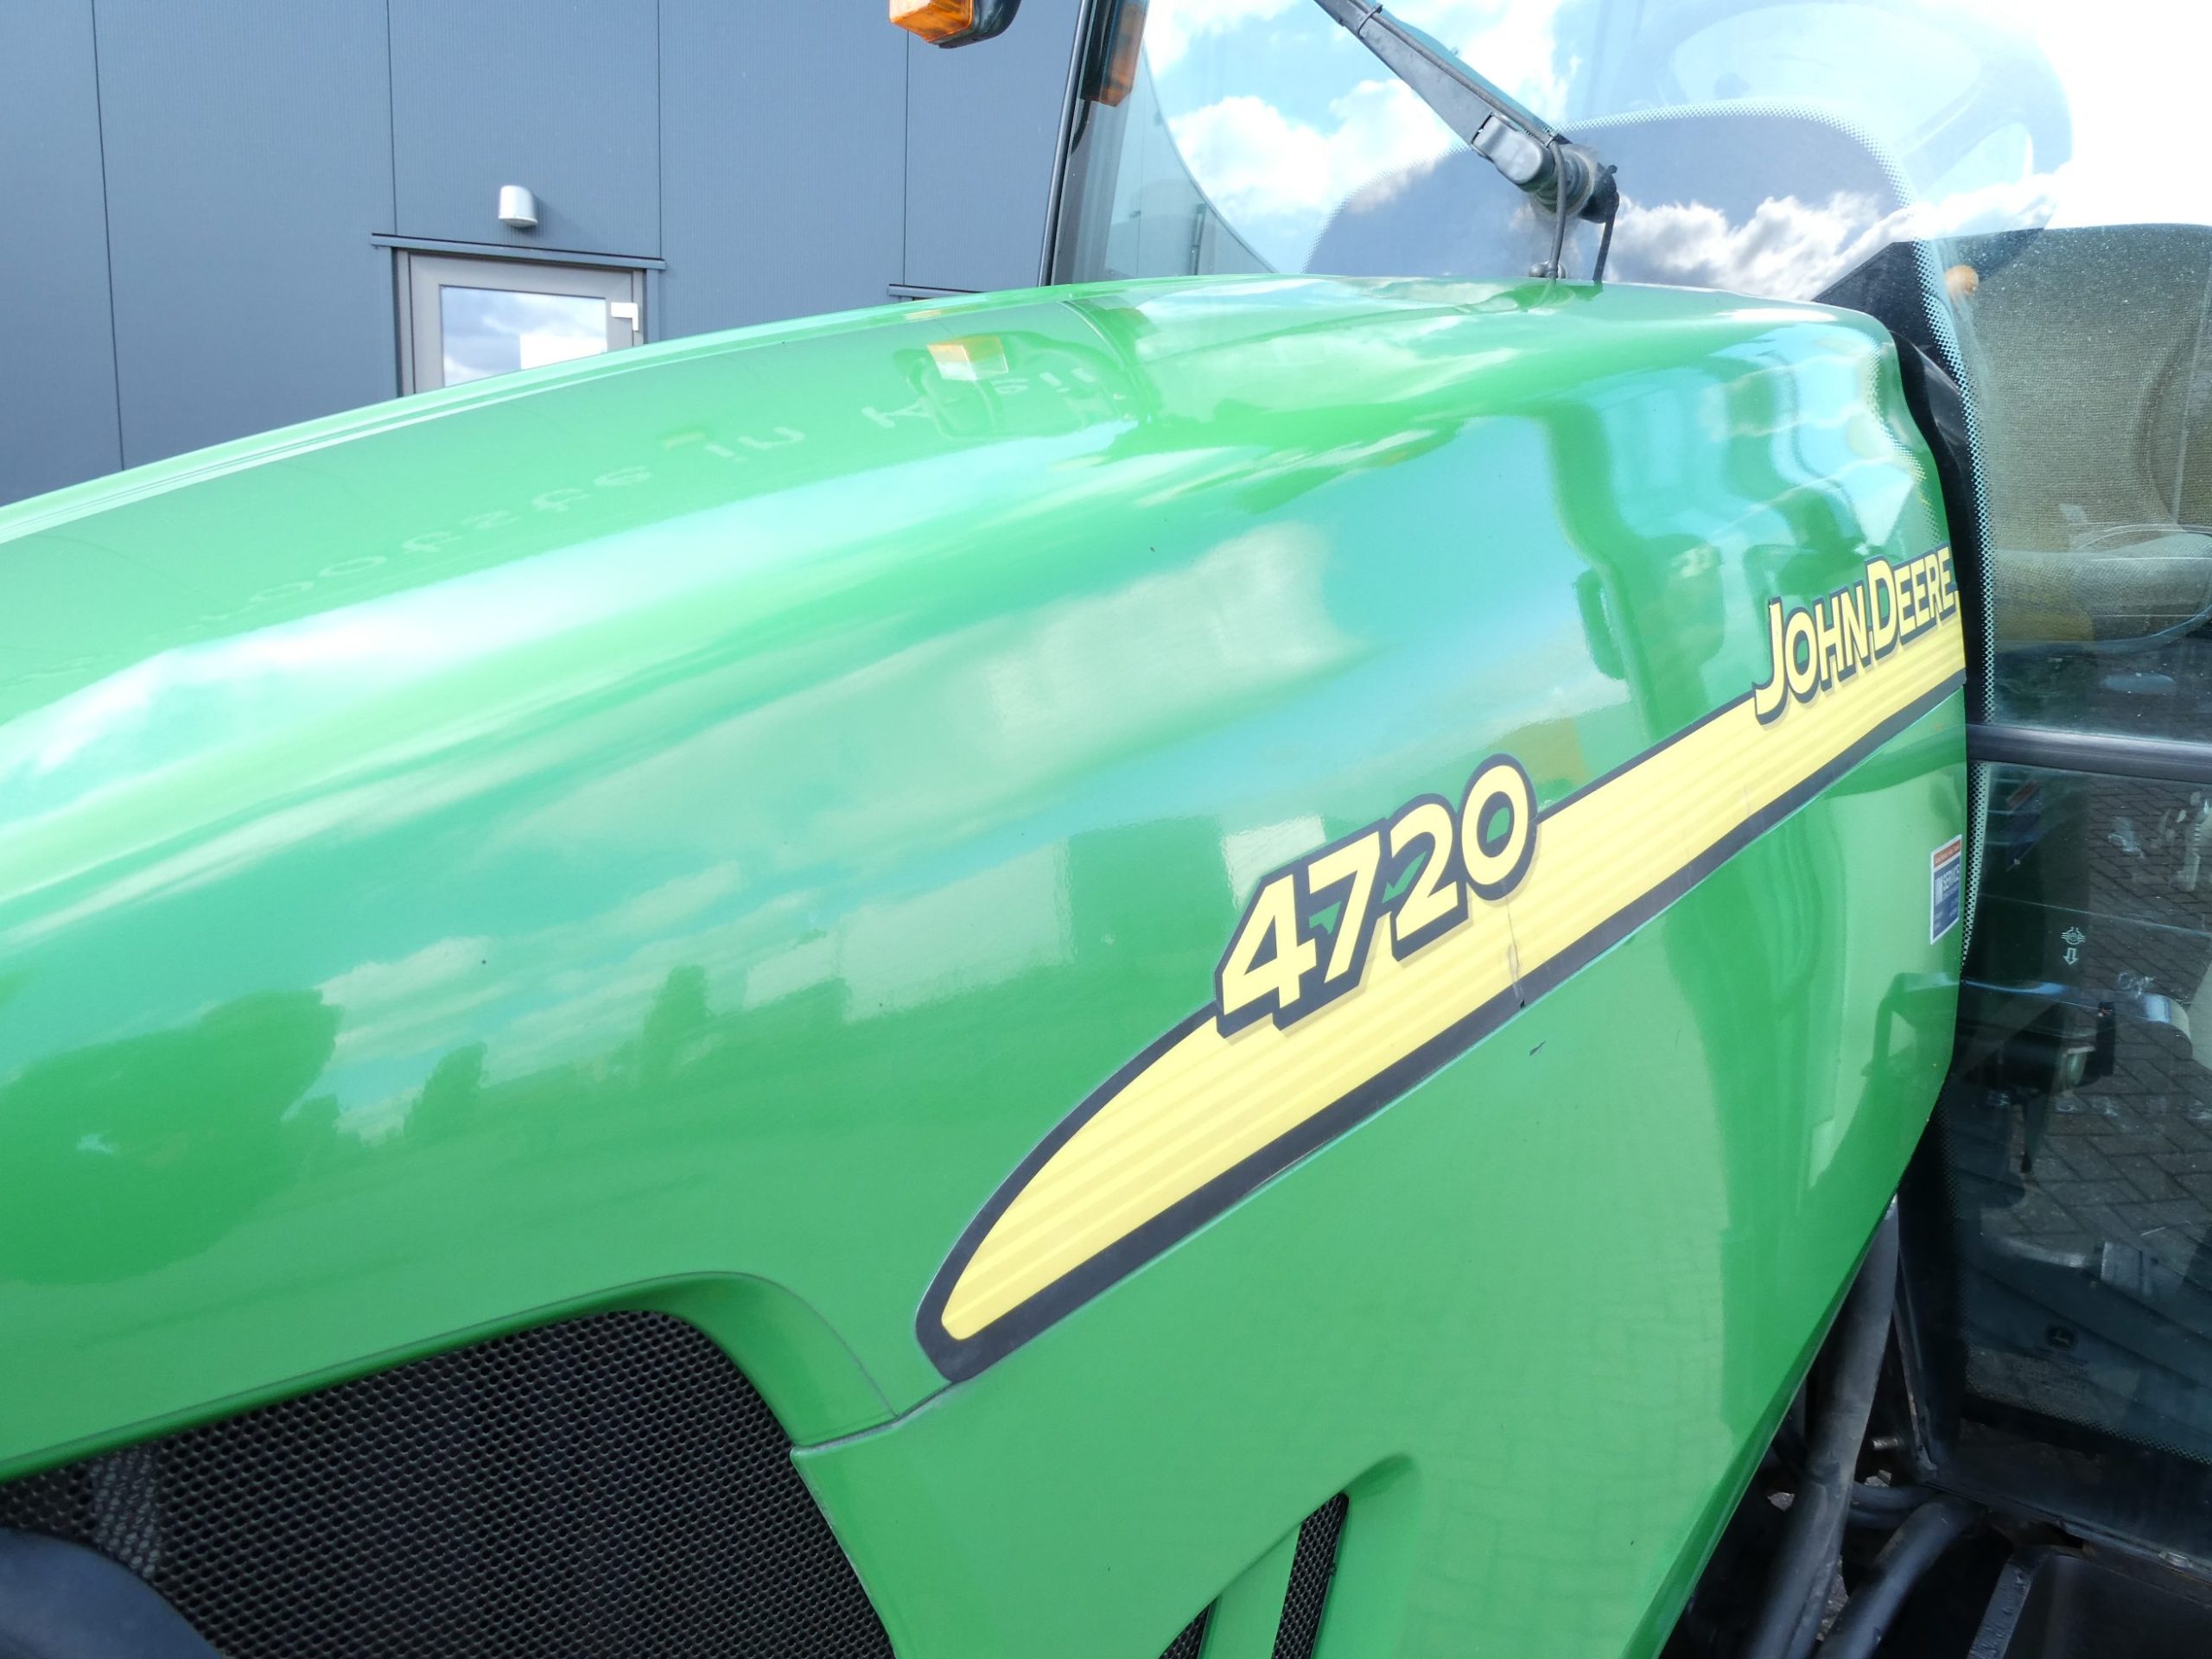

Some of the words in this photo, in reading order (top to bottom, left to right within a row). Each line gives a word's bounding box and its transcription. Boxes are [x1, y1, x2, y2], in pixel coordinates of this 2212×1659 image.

[1753, 581, 1872, 722] JOHN
[1865, 544, 1959, 654] DEERE
[1217, 757, 1533, 1030] 4720
